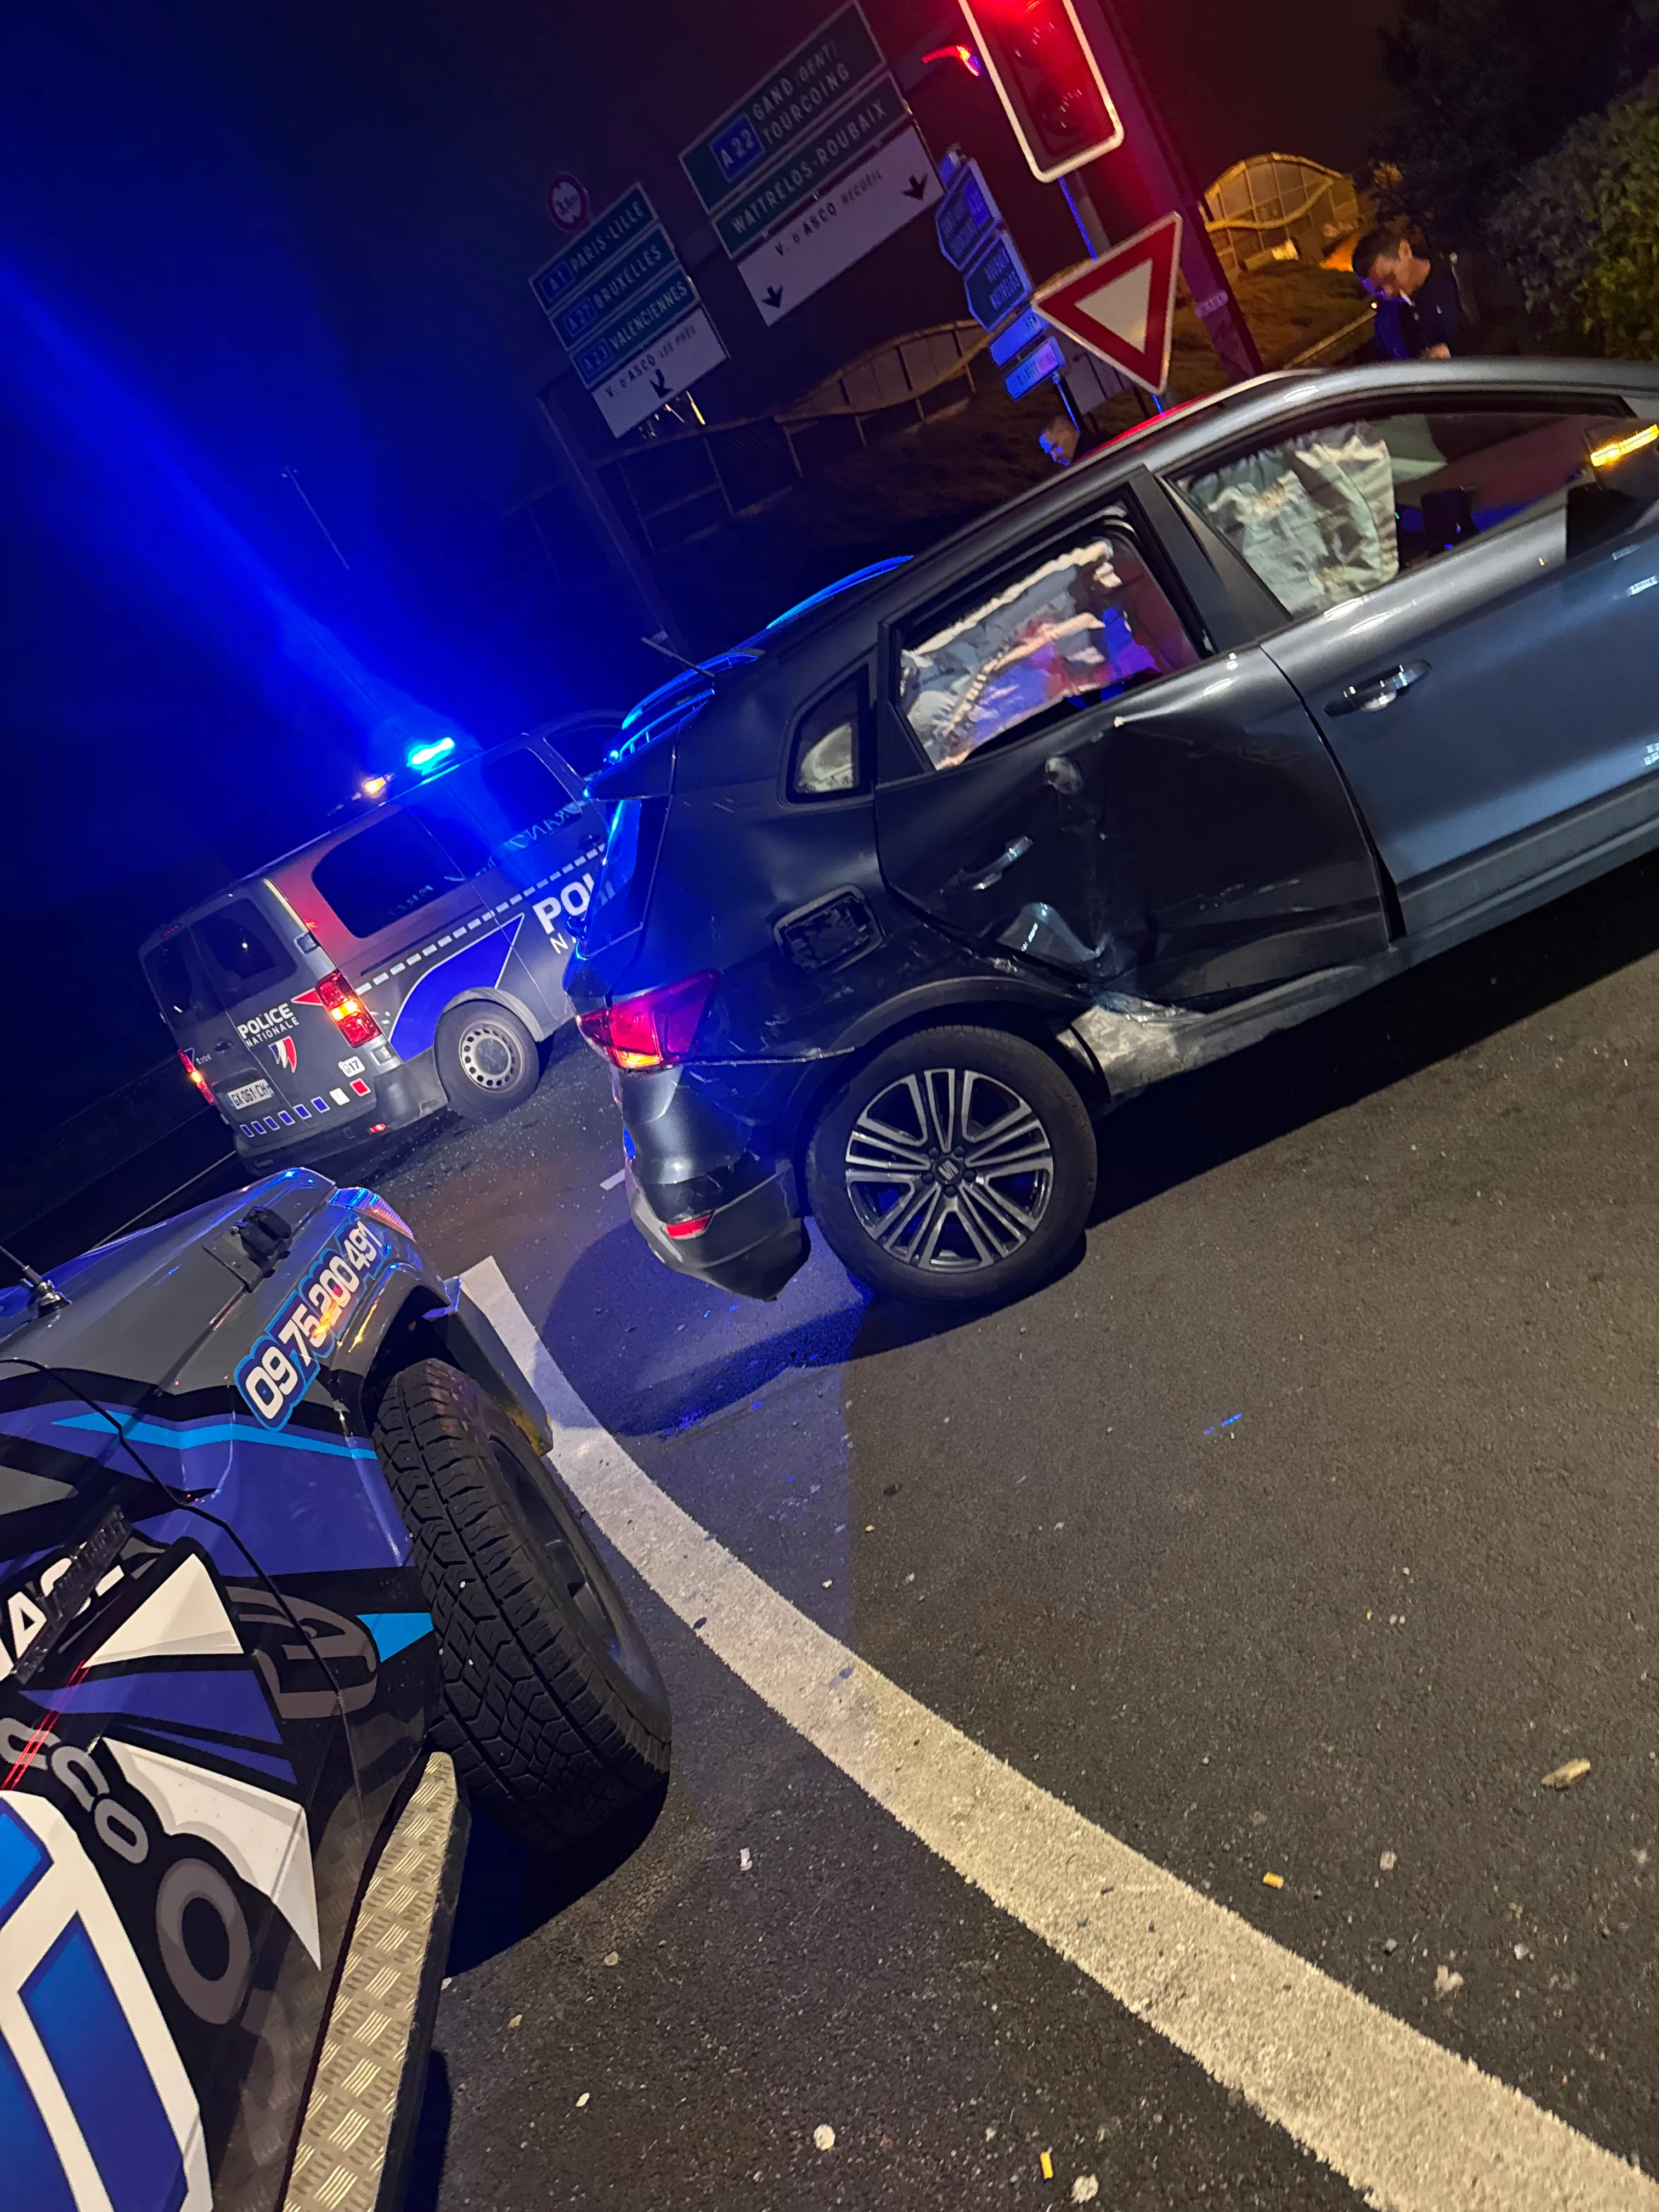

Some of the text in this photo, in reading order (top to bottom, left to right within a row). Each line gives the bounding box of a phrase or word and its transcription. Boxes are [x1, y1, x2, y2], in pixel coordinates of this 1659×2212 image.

[761, 63, 850, 144] TOURCOING
[594, 245, 662, 309] BRUXELLES
[609, 281, 688, 349] VALENCIENNES
[237, 1003, 294, 1039] POLICE
[245, 1017, 300, 1048] NATIONALE
